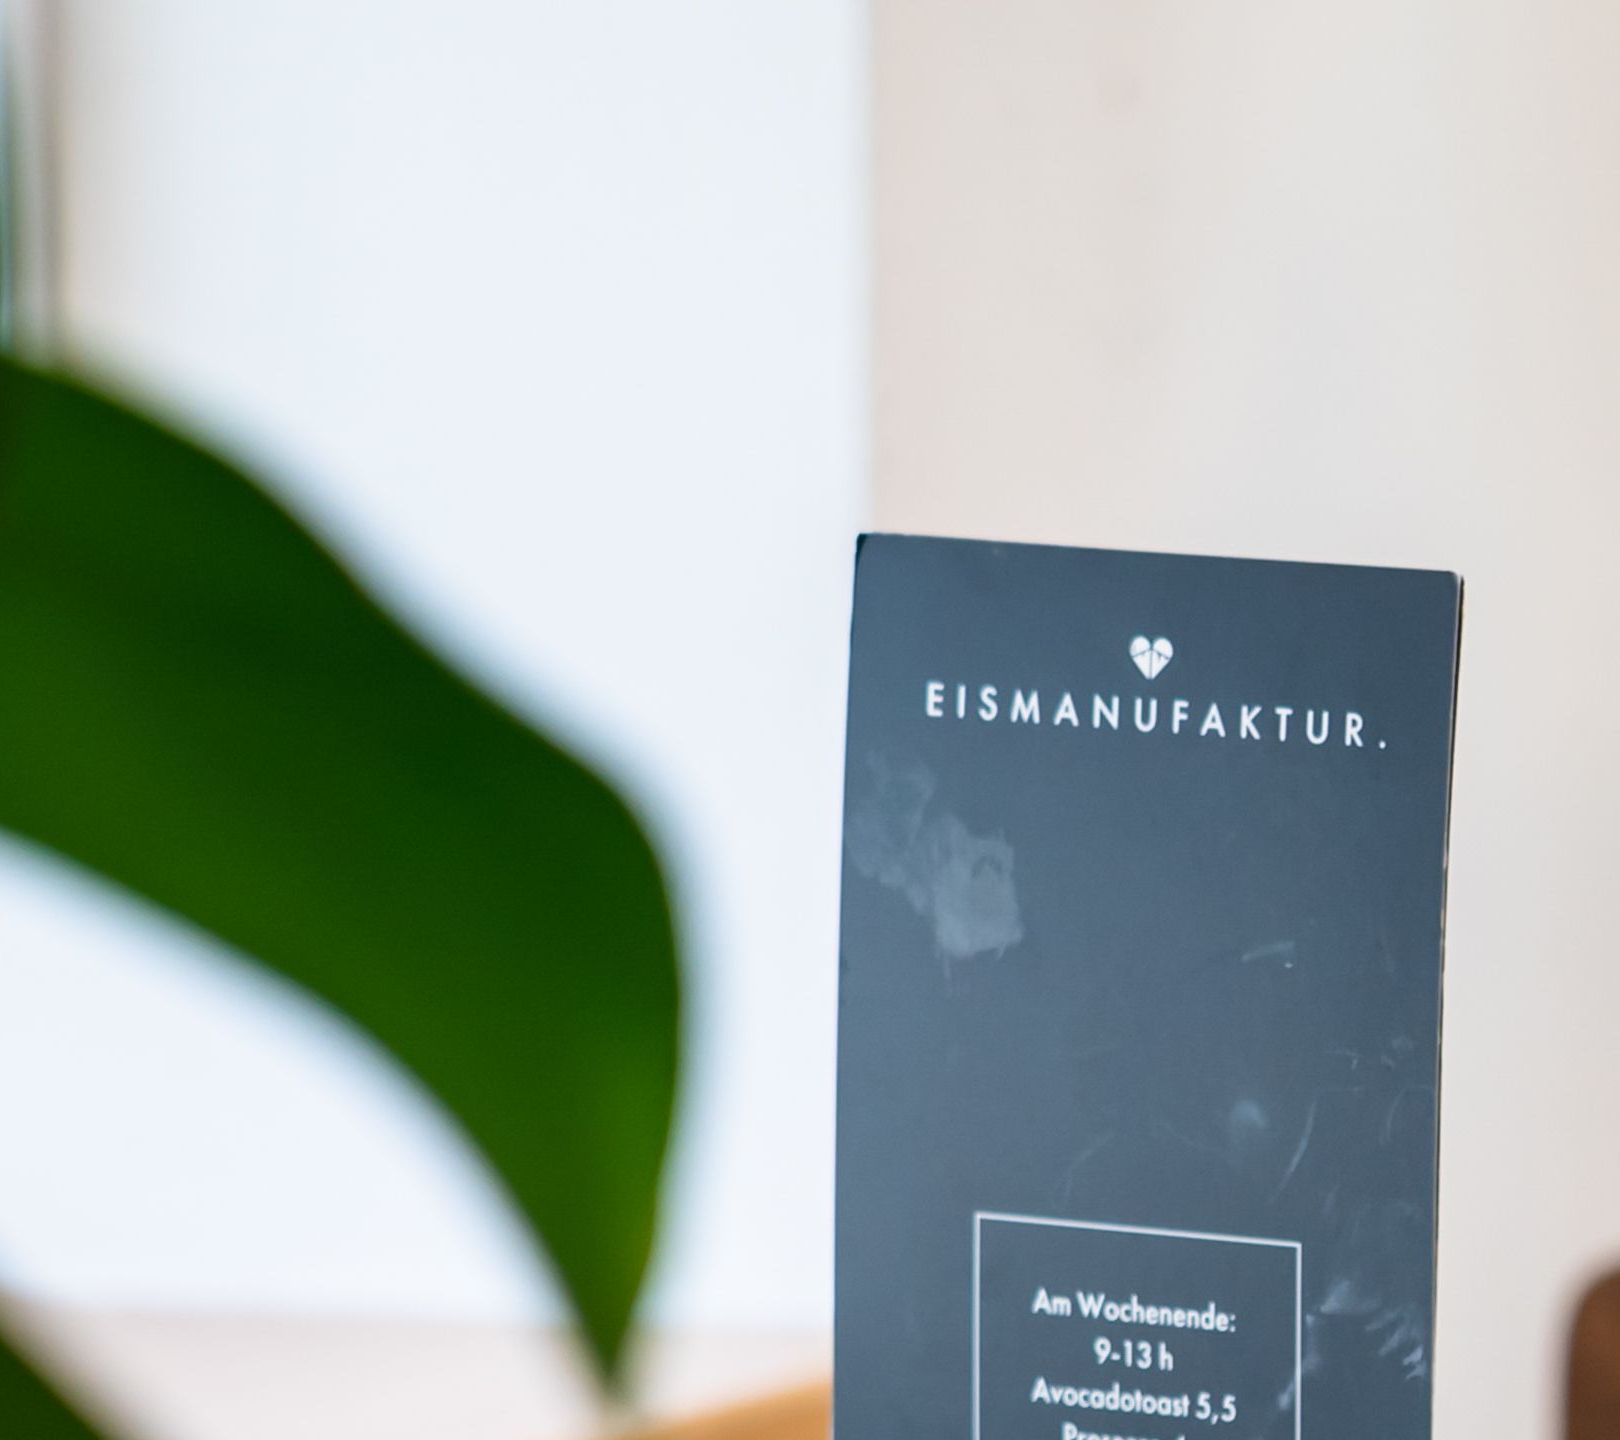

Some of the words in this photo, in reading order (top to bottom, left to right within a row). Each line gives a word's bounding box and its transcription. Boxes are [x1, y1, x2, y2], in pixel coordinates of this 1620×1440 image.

[925, 680, 1389, 750] EISMANUFAKTUR.
[1032, 1286, 1071, 1318] Am
[1078, 1290, 1237, 1333] Wochenende:
[1094, 1335, 1153, 1370] 9-13
[1159, 1342, 1174, 1371] h
[1031, 1376, 1190, 1419] Avocadotoast
[1195, 1392, 1237, 1424] 5,5
